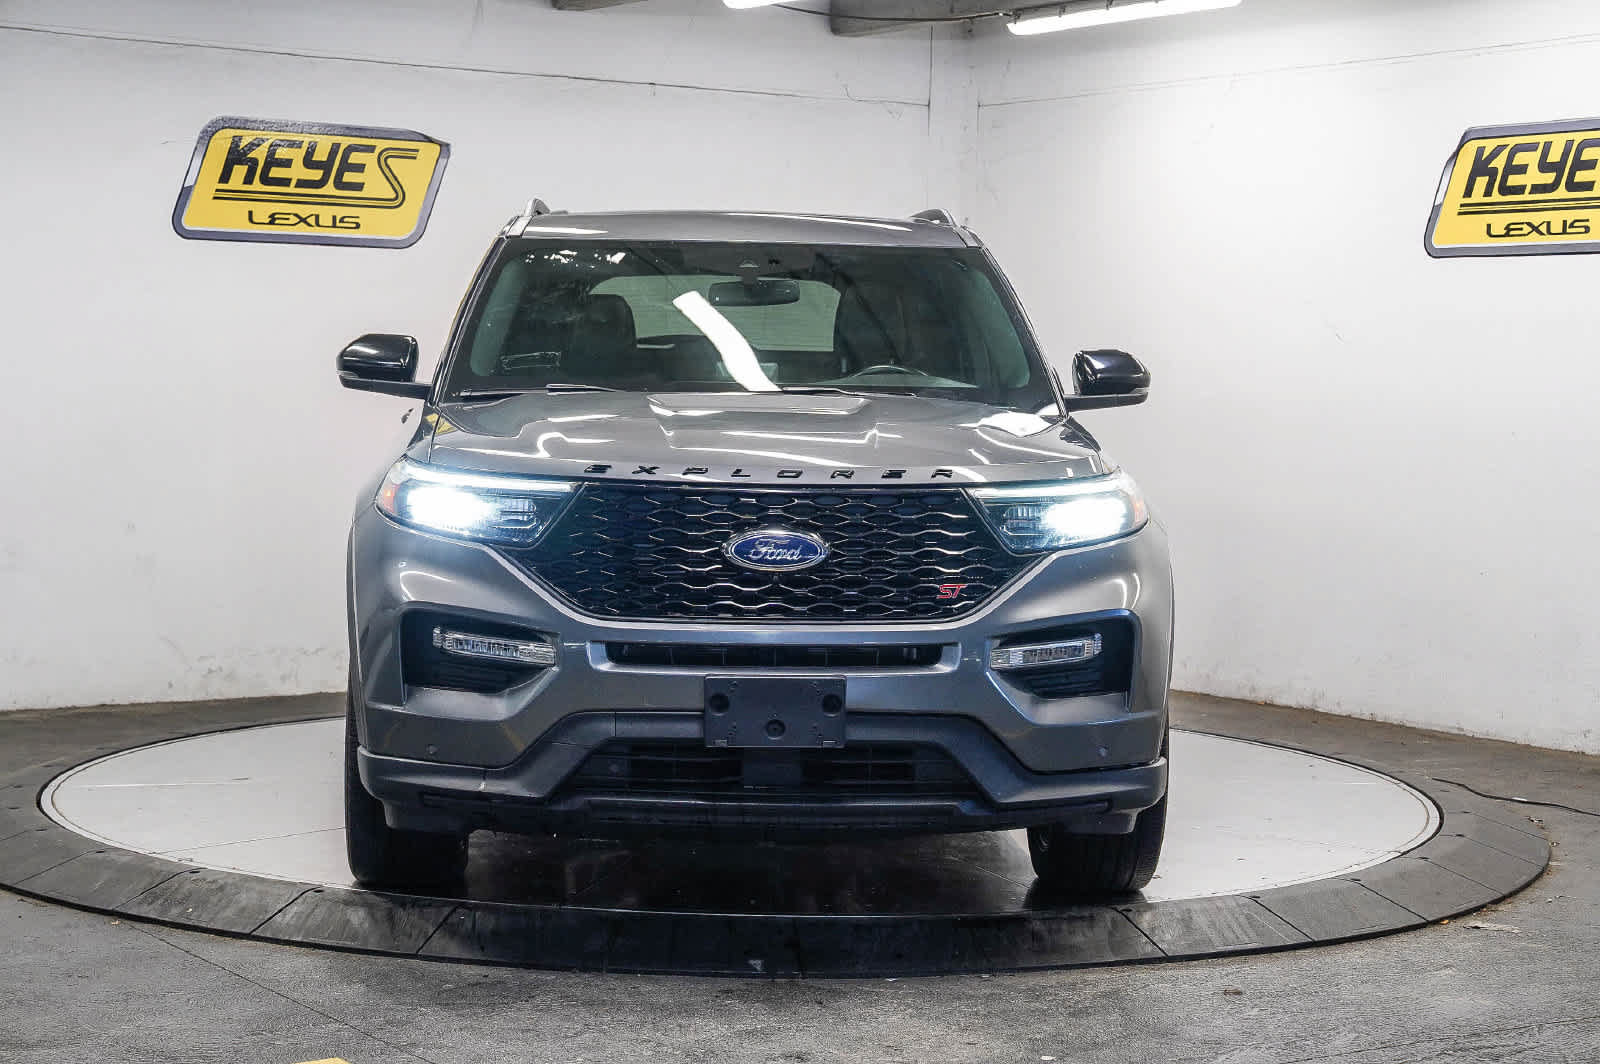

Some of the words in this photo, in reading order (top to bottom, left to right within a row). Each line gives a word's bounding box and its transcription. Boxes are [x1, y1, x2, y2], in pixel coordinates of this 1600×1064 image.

[214, 135, 419, 206] KEYES
[1462, 138, 1600, 198] KEYE
[248, 210, 361, 230] LEXUS
[1486, 219, 1591, 238] LEXUS
[583, 464, 953, 479] EXPLORER
[746, 538, 806, 560] Ford
[936, 584, 968, 599] ST
